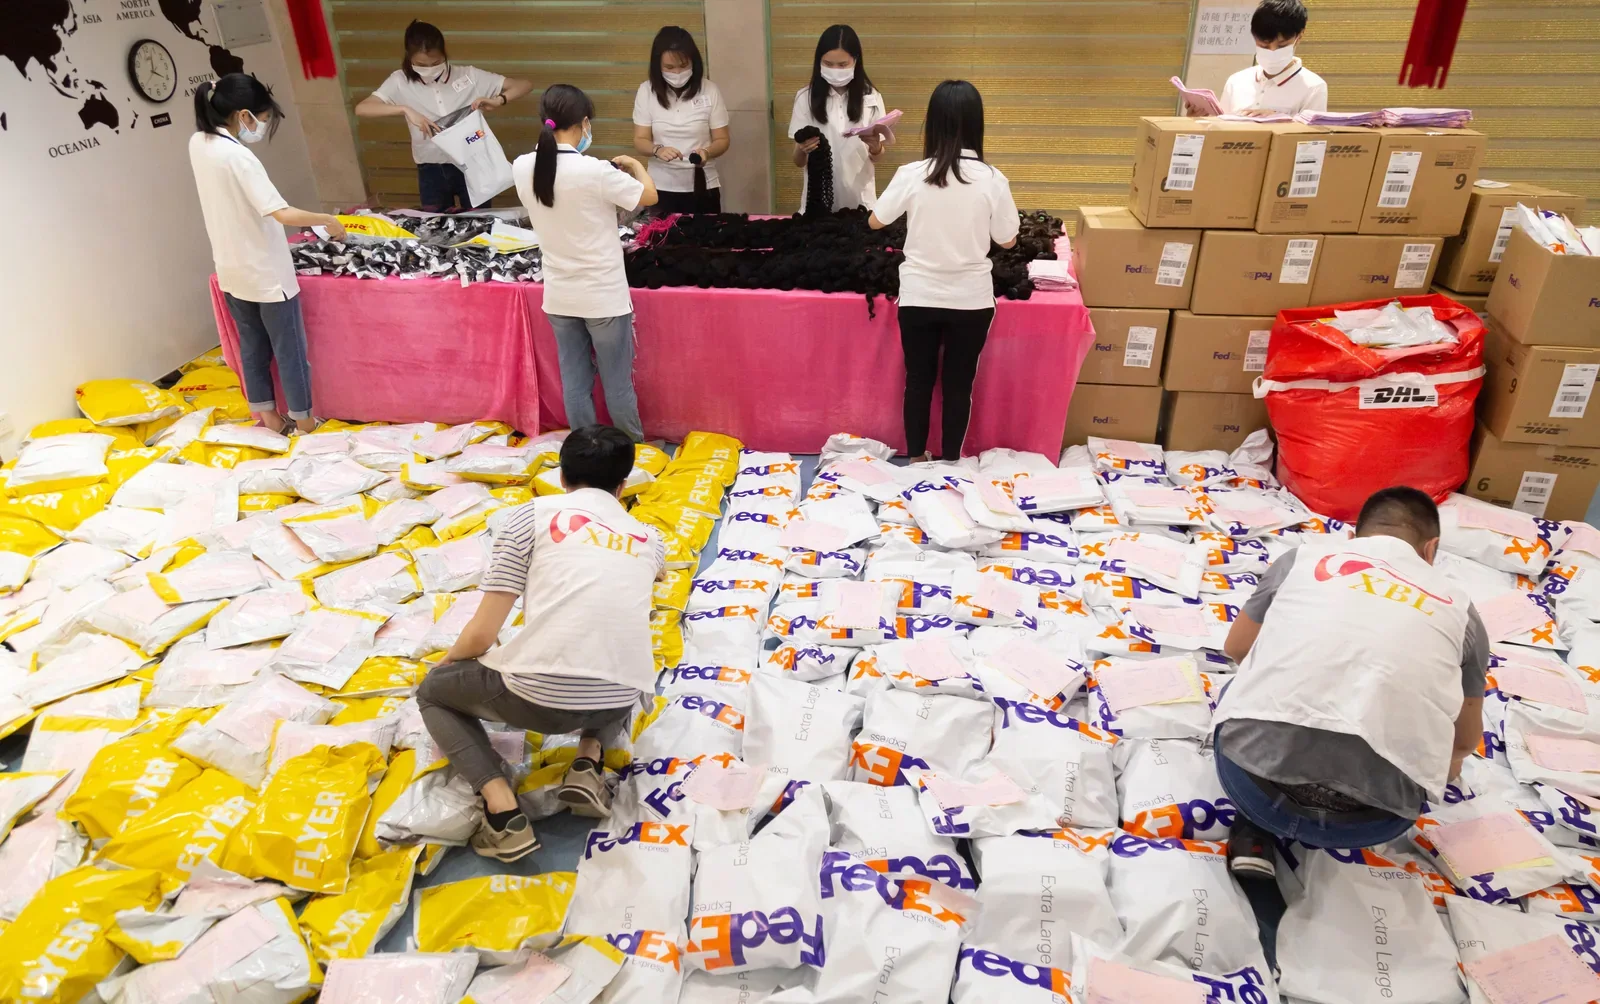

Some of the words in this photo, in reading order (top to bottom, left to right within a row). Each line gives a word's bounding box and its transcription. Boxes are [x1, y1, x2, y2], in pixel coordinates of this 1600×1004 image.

[120, 0, 150, 9] NORTH
[83, 14, 102, 24] ASIA
[116, 10, 155, 21] AMERICA
[188, 73, 215, 85] SOUTH
[153, 116, 169, 125] CHINA
[48, 137, 101, 158] OCEANIA
[1222, 142, 1256, 150] DHL
[1330, 145, 1362, 153] DHL
[1276, 181, 1288, 198] 6
[1377, 216, 1412, 224] DHL
[1373, 386, 1427, 403] DHL
[1523, 426, 1561, 435] DHL
[1552, 454, 1591, 466] DHL
[1477, 478, 1490, 491] 6
[583, 526, 641, 558] XBL
[1349, 573, 1435, 616] XBL
[795, 713, 813, 742] Extra
[807, 686, 821, 711] Large
[870, 733, 907, 752] Express
[1066, 761, 1079, 793] Extra
[1132, 793, 1175, 811] Express
[1060, 797, 1078, 828] Larg
[176, 795, 257, 882] FLYER
[294, 790, 347, 881] FLYER
[585, 821, 690, 861] FedEx
[638, 843, 670, 853] Express
[1040, 874, 1057, 914] Extra
[1193, 887, 1209, 927] Extra
[622, 905, 635, 930] Larg
[902, 911, 947, 931] Express
[1371, 905, 1388, 946] Extra
[1036, 919, 1056, 965] Large
[1190, 931, 1209, 971] Larg
[631, 957, 665, 972] Express
[879, 945, 902, 986] Extra
[1375, 952, 1394, 998] Large
